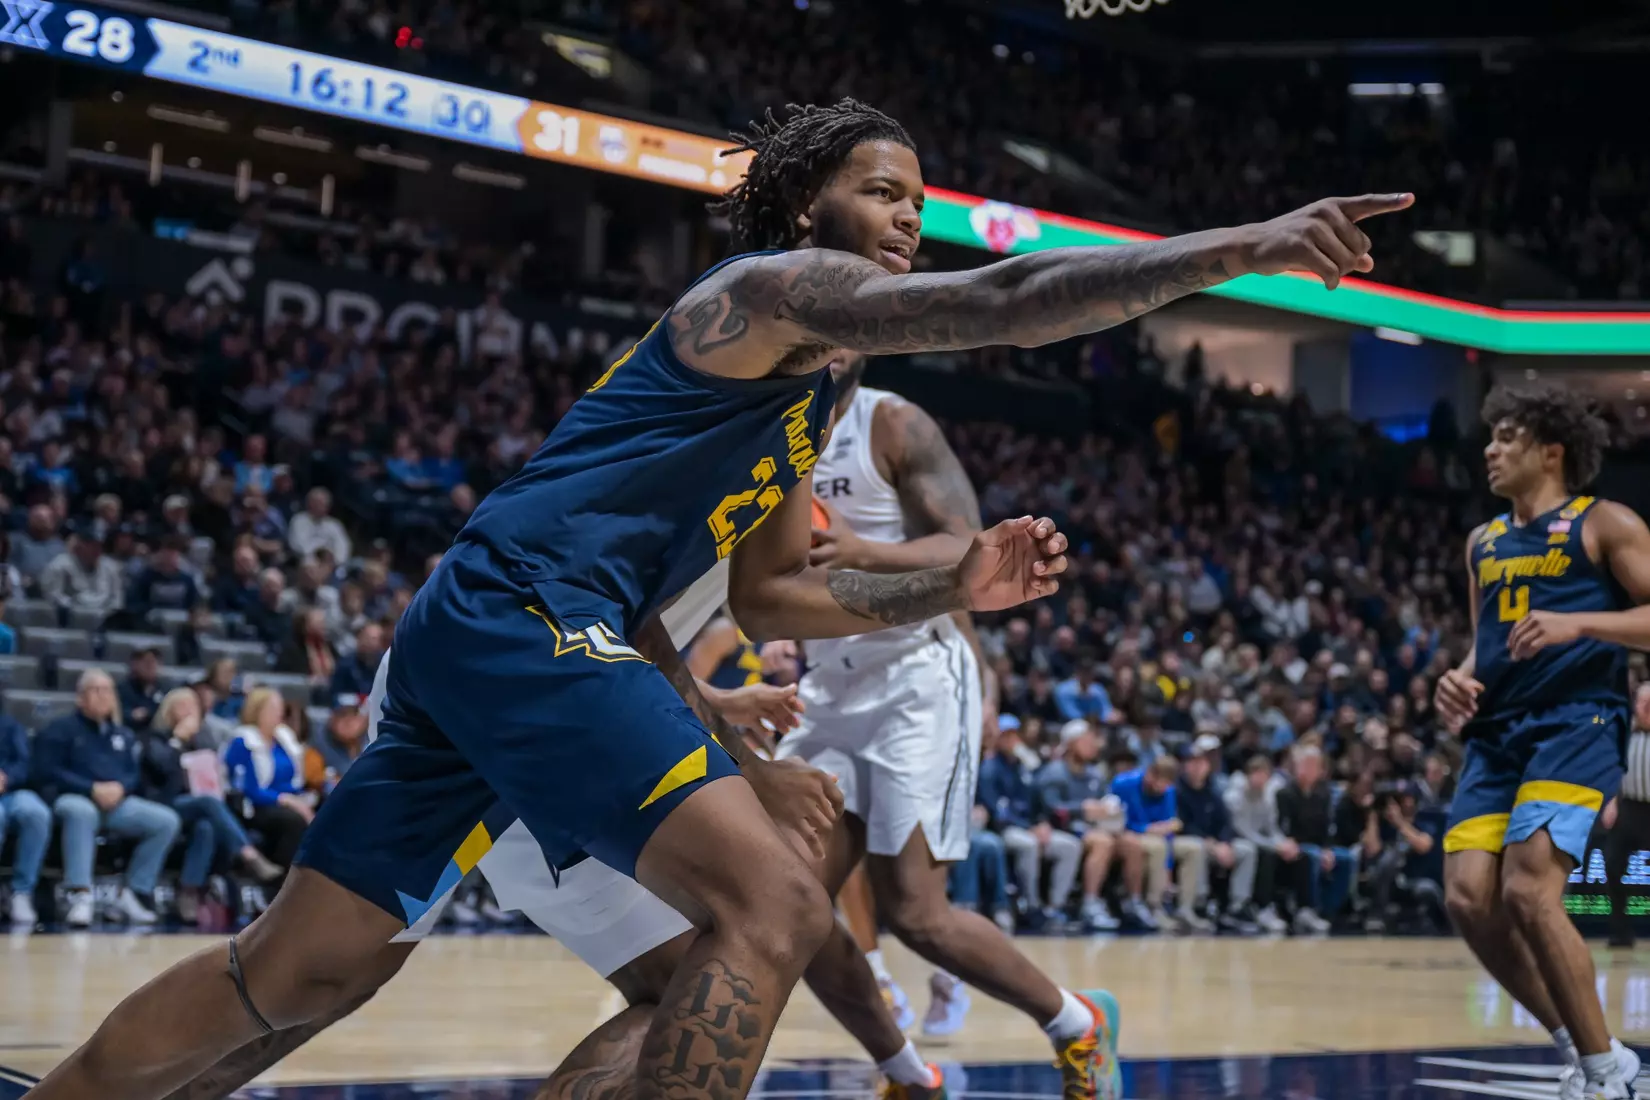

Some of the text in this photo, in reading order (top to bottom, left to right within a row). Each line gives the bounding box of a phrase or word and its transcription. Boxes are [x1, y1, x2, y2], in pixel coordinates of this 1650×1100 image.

[62, 10, 135, 63] 28
[186, 40, 243, 75] 2nd
[287, 62, 409, 118] 16:12
[533, 110, 581, 156] 31
